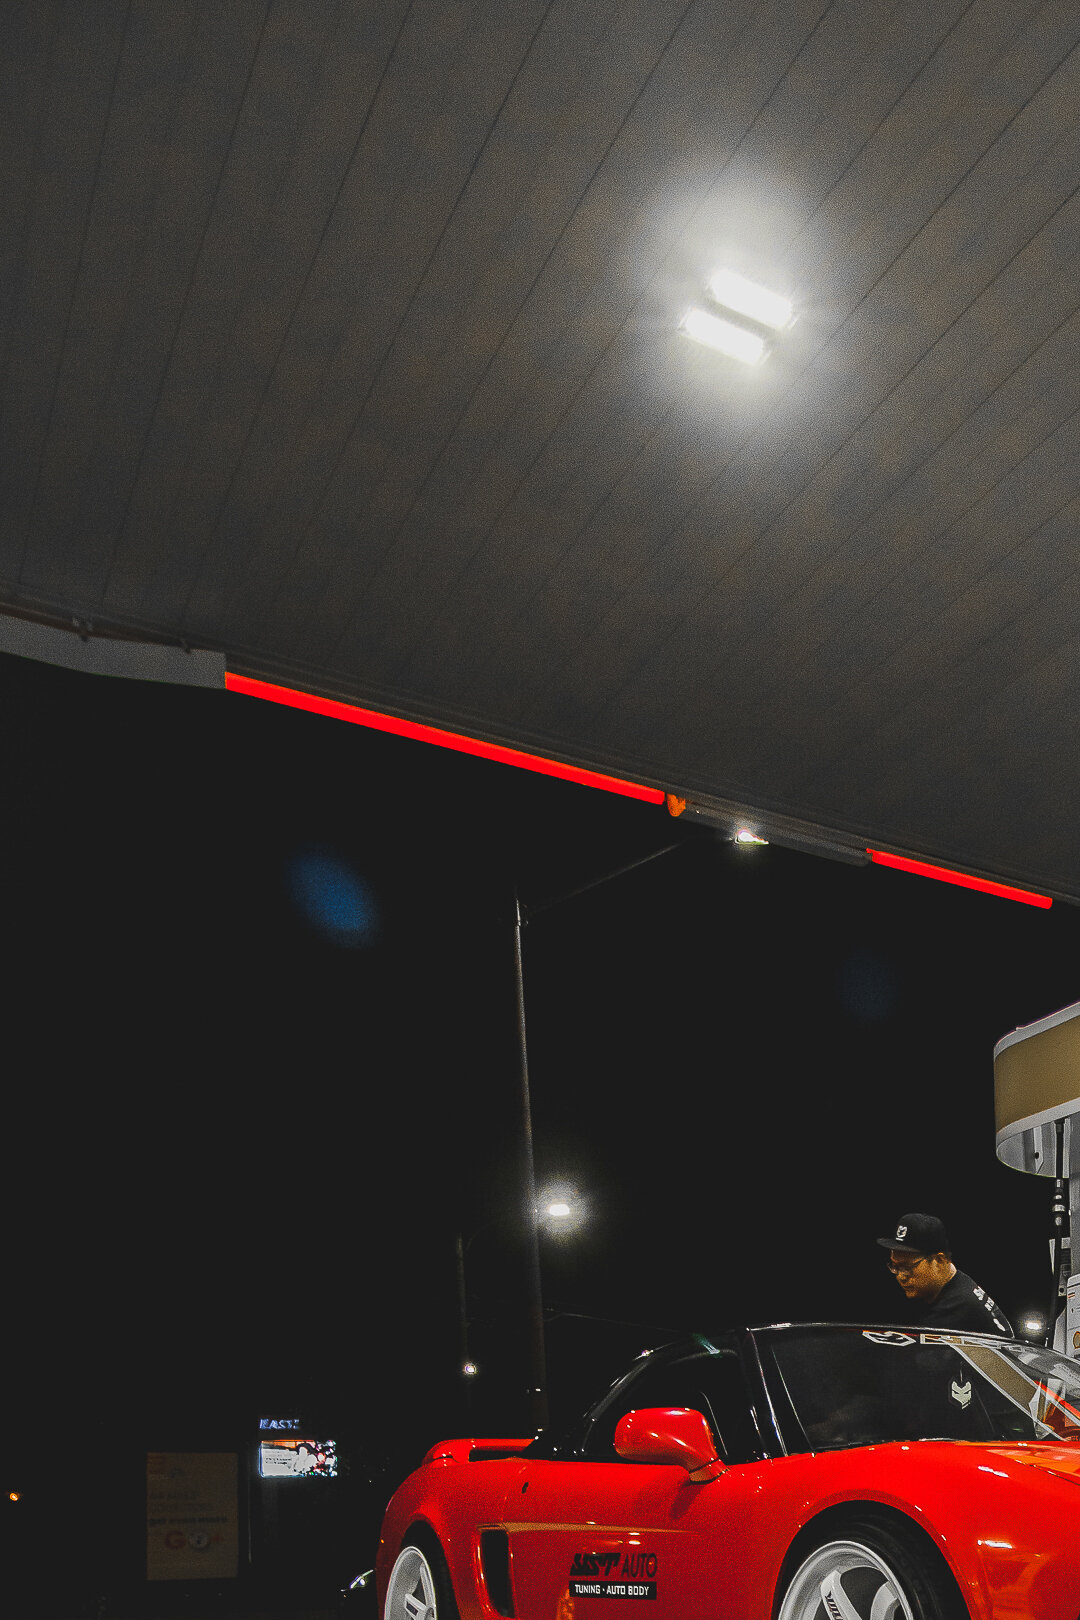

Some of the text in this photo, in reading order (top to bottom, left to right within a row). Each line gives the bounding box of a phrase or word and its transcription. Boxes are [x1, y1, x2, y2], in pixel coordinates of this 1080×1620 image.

[621, 1552, 658, 1578] AUTO
[574, 1584, 650, 1596] TUNING AUTO BODY
